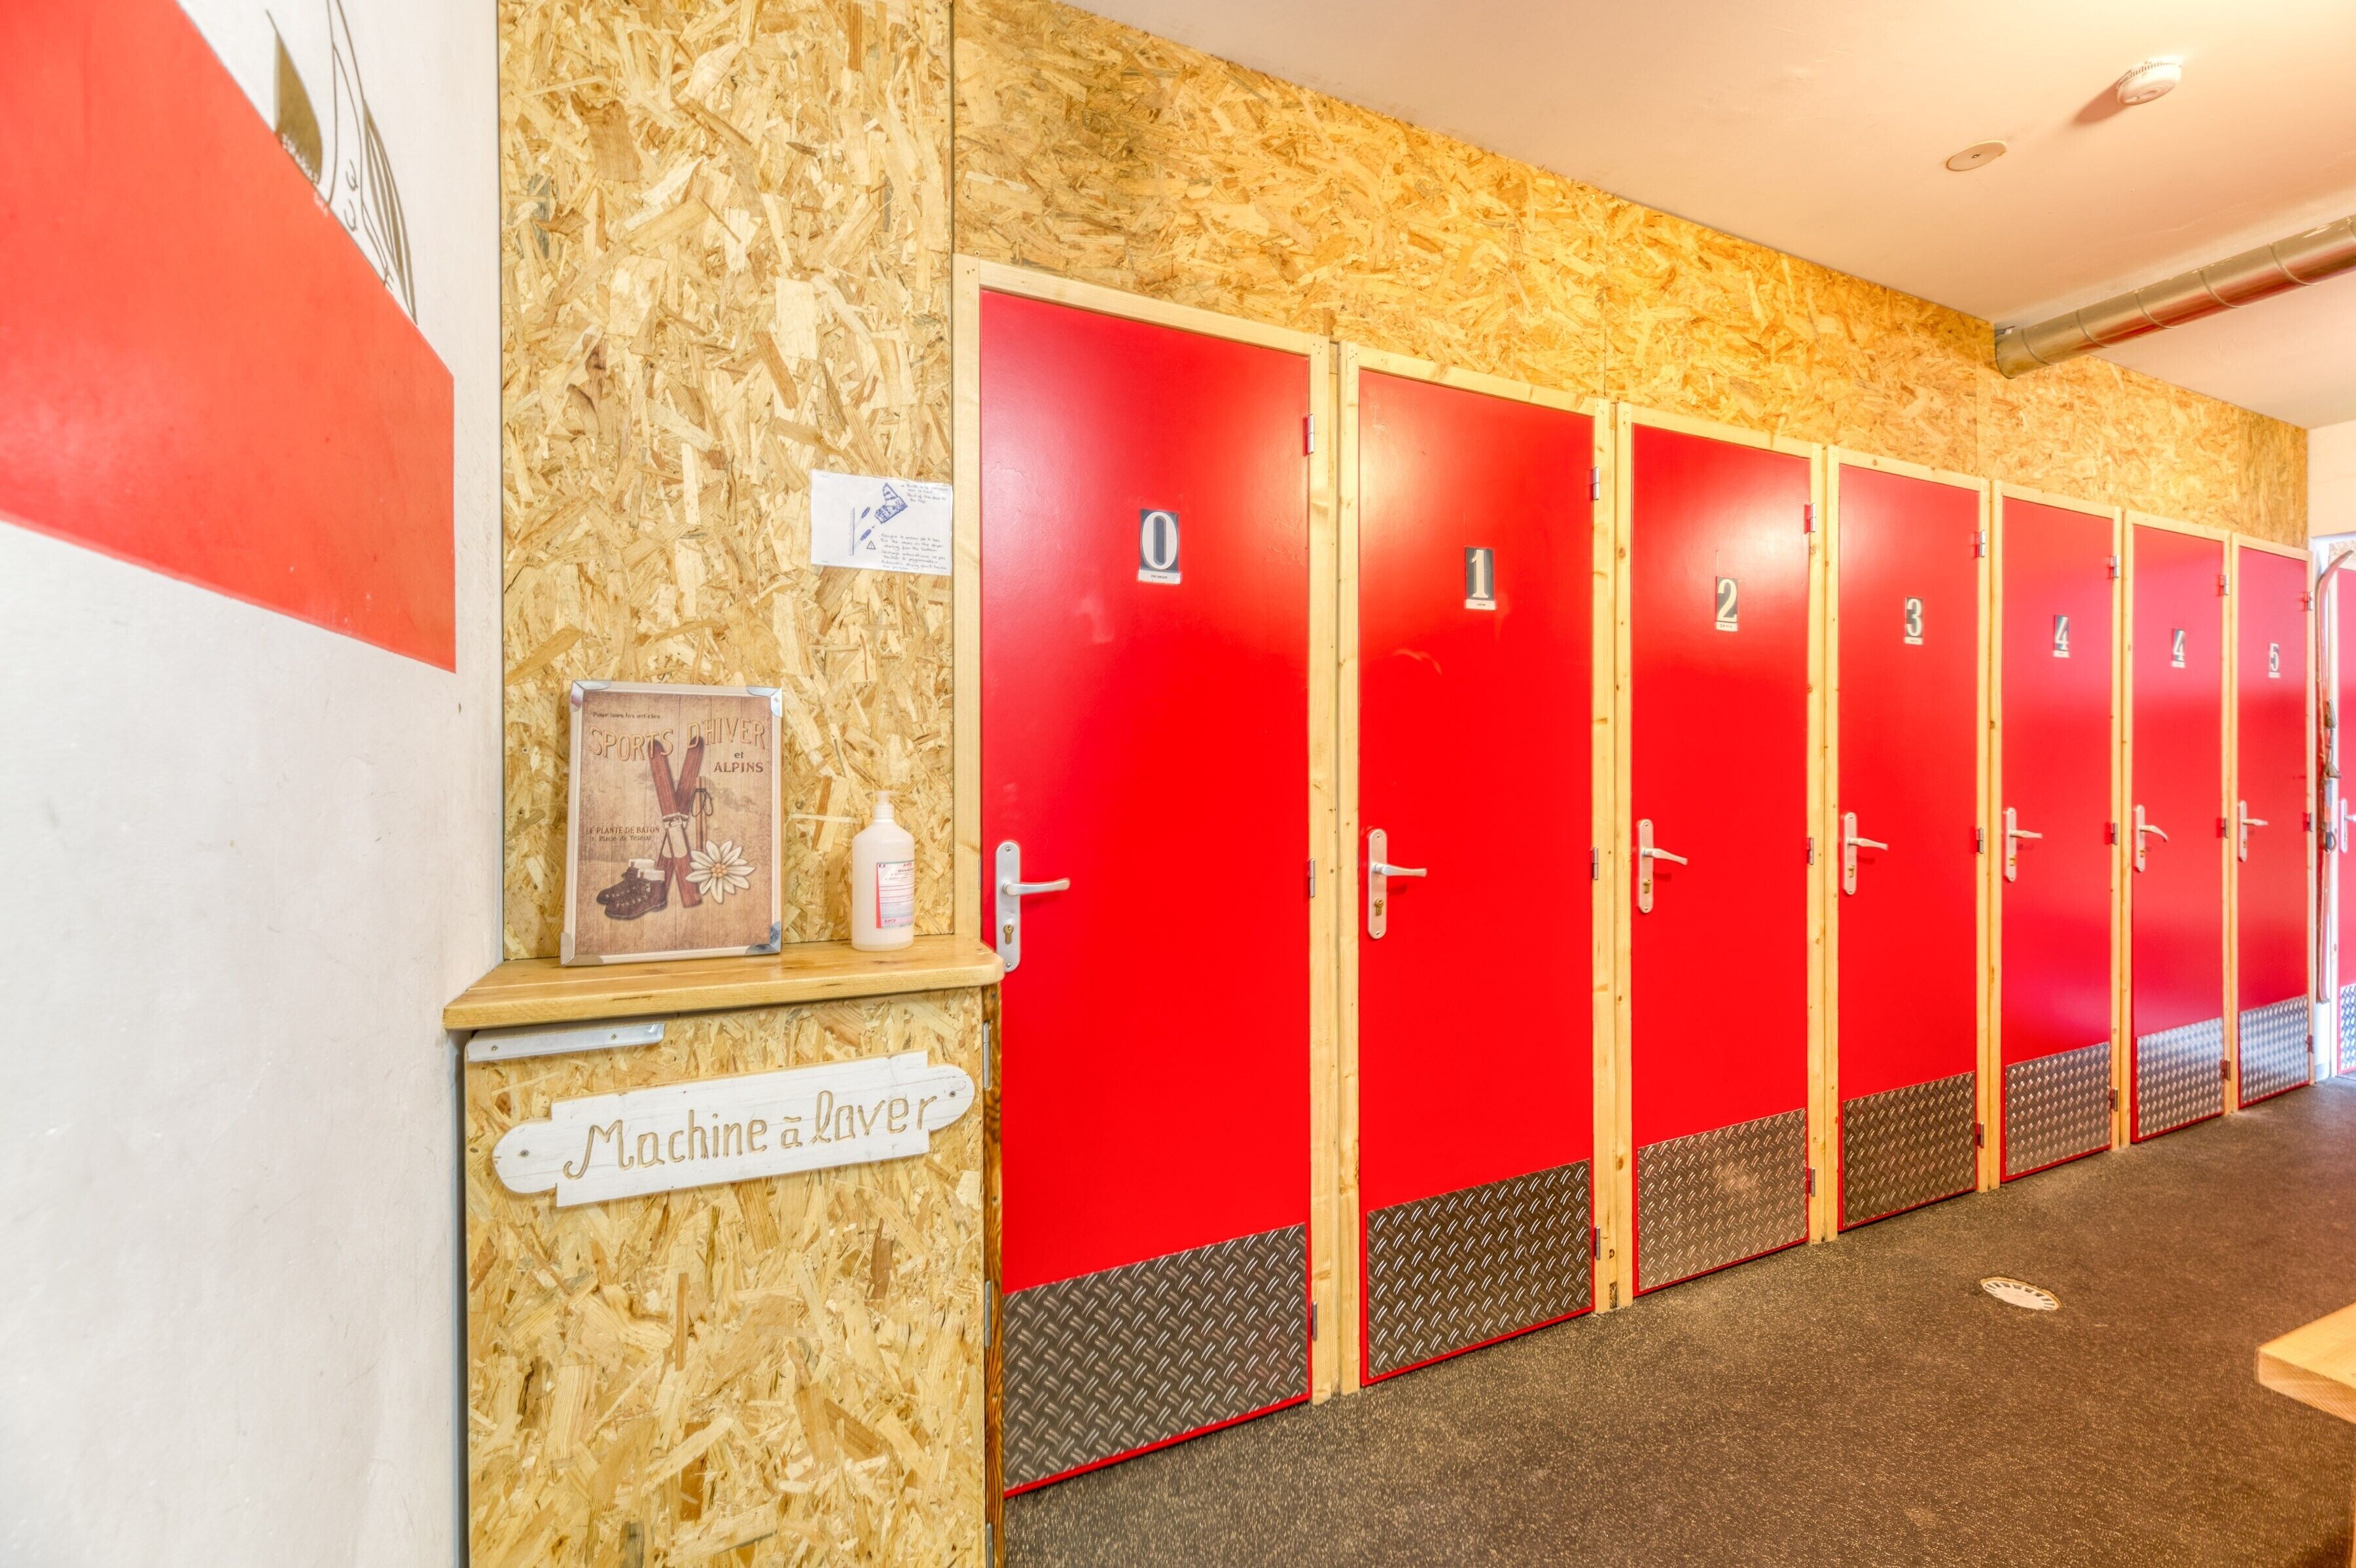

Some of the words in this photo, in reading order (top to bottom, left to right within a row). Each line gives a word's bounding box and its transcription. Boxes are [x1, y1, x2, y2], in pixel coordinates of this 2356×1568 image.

[1142, 512, 1177, 569] 0
[1472, 549, 1489, 598] 1
[1717, 579, 1738, 622] 2
[1906, 598, 1922, 637] 3
[2055, 616, 2069, 650] 4
[2173, 630, 2185, 661] 4
[2270, 643, 2279, 671] 5
[589, 725, 673, 762] SPORTS
[687, 717, 766, 750] D'HIVER
[714, 762, 764, 773] ALPINS
[563, 1109, 768, 1180] Machine
[809, 1090, 937, 1145] laver
